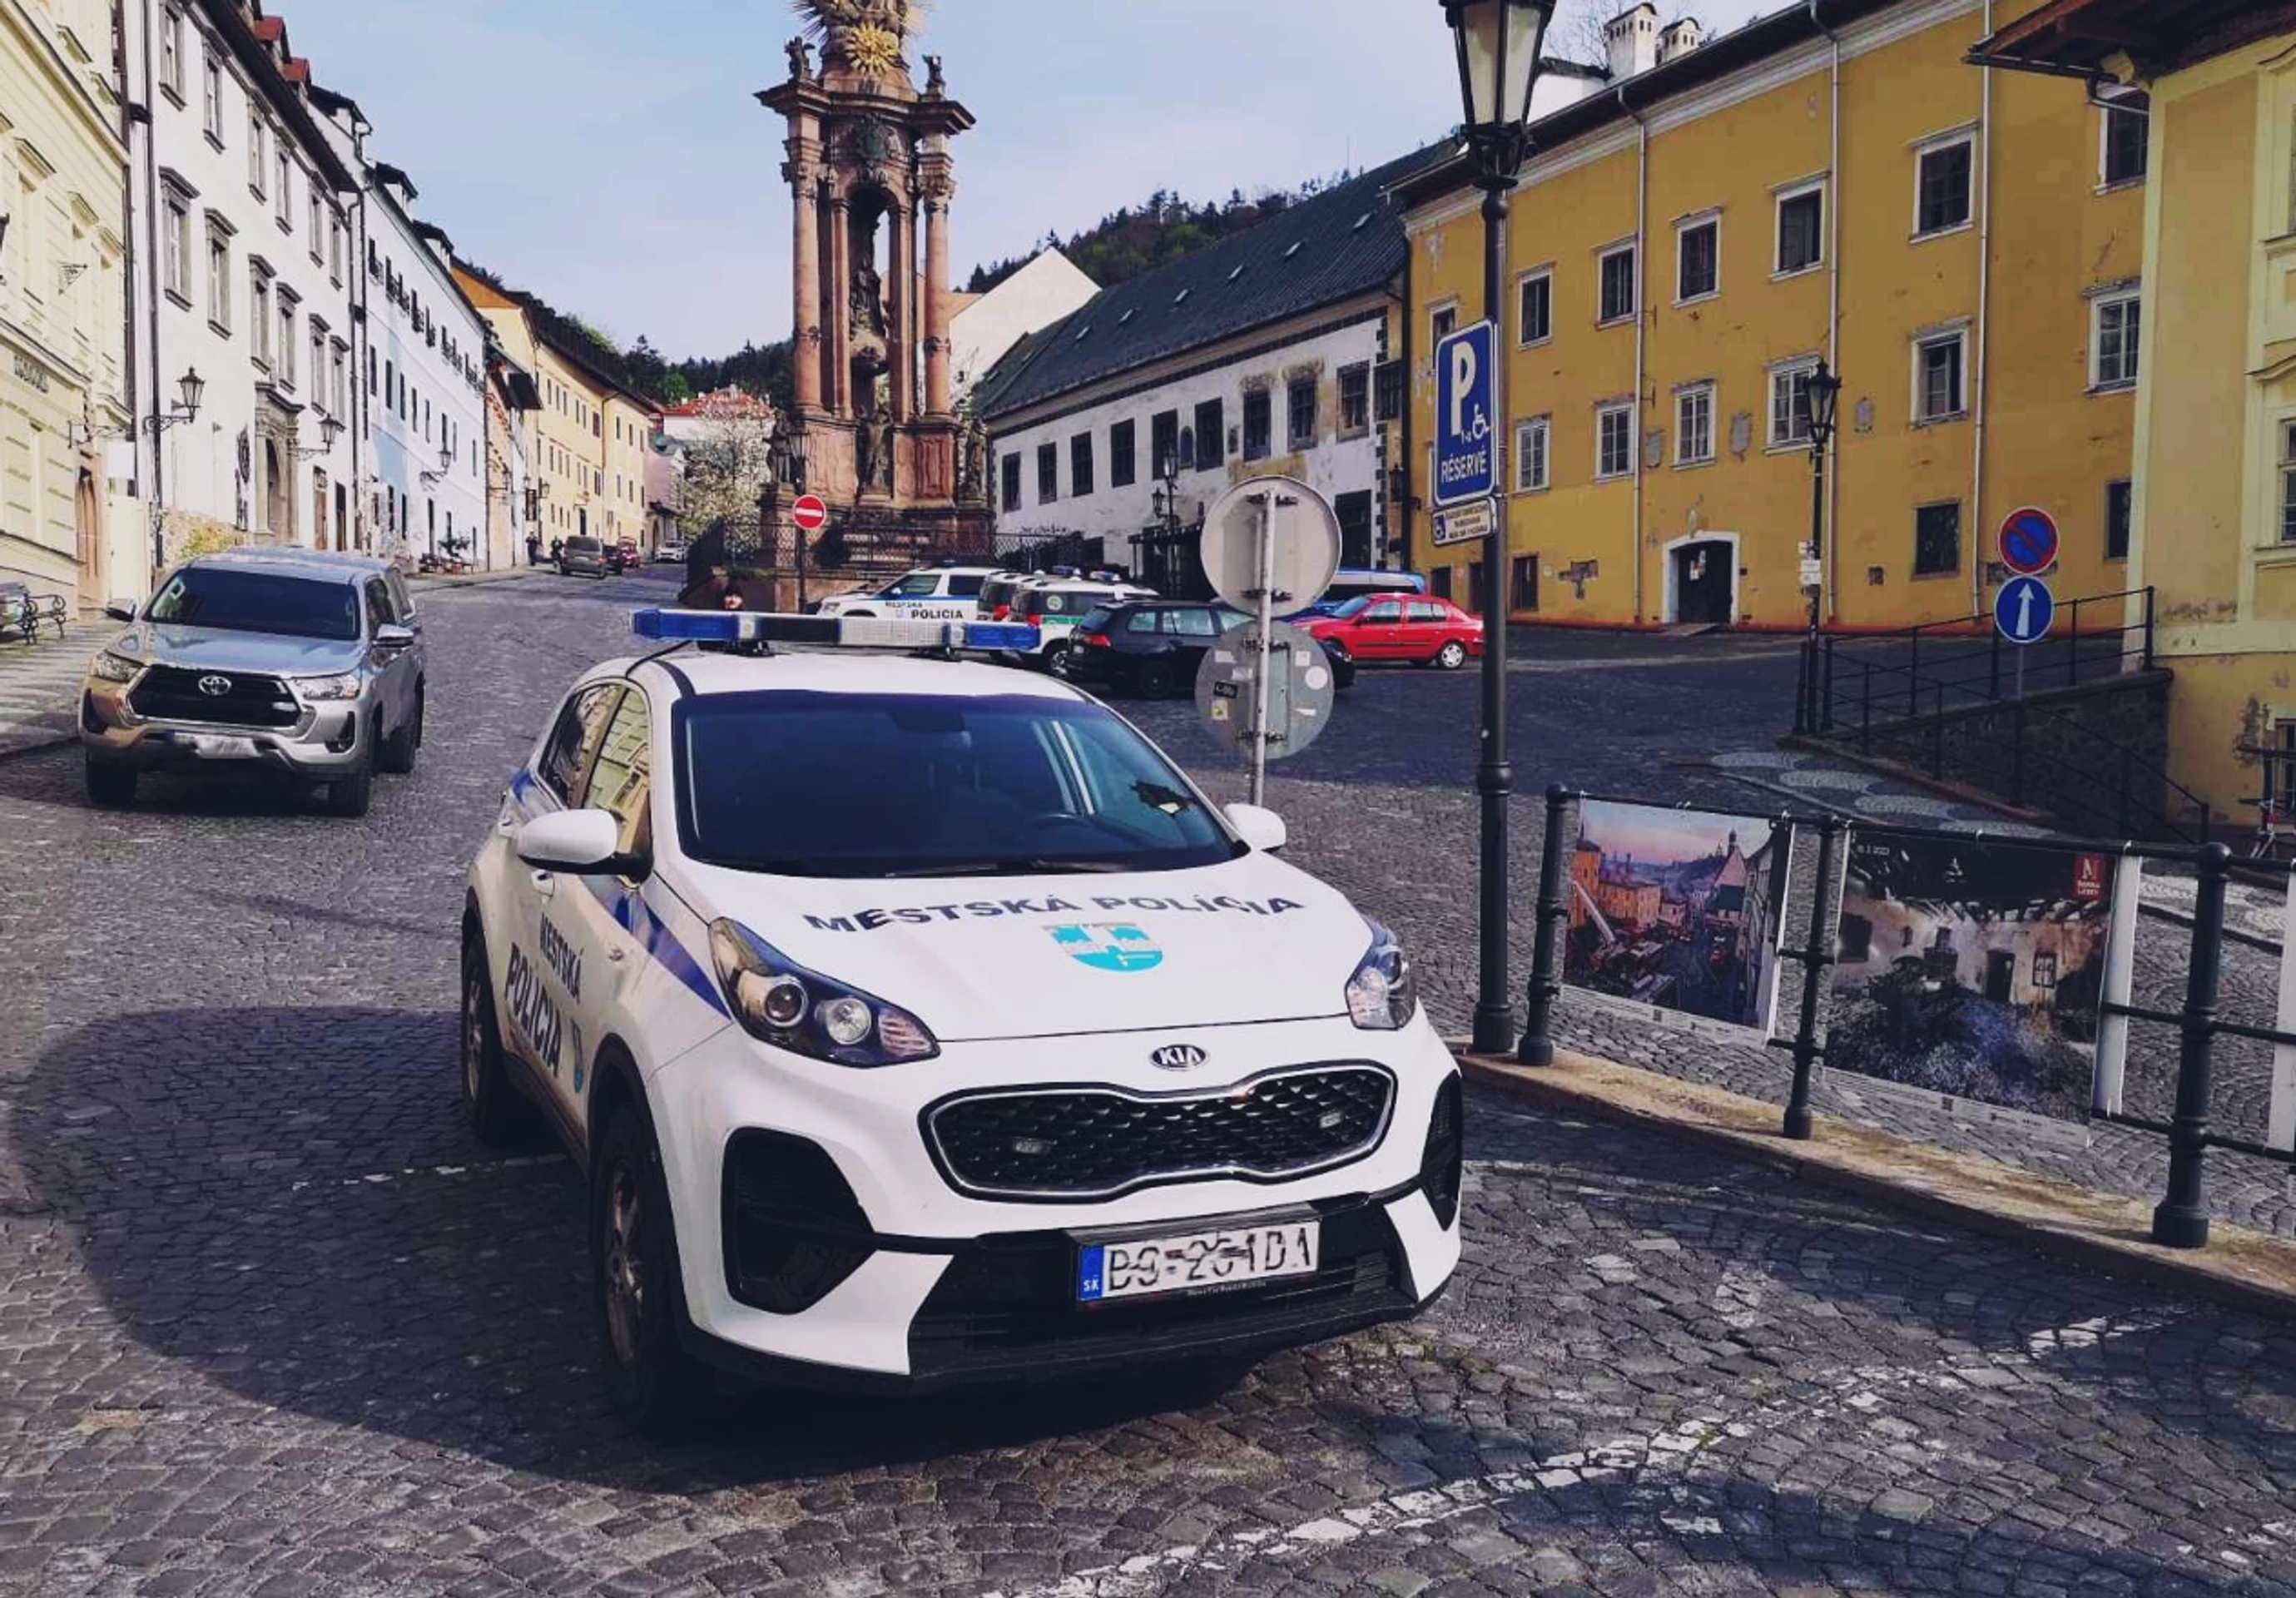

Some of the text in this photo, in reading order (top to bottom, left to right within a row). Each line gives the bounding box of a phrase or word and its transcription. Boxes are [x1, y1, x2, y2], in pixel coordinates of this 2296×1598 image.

[1450, 341, 1476, 436] P
[1441, 444, 1487, 483] RÉSERVÉ
[802, 893, 1304, 933] MESTSKÁ POLÍCIA
[539, 910, 584, 1005] MESTSKÁ
[504, 940, 562, 1079] POLÍCIA
[1158, 1047, 1202, 1065] KIA
[1082, 1278, 1099, 1292] SK
